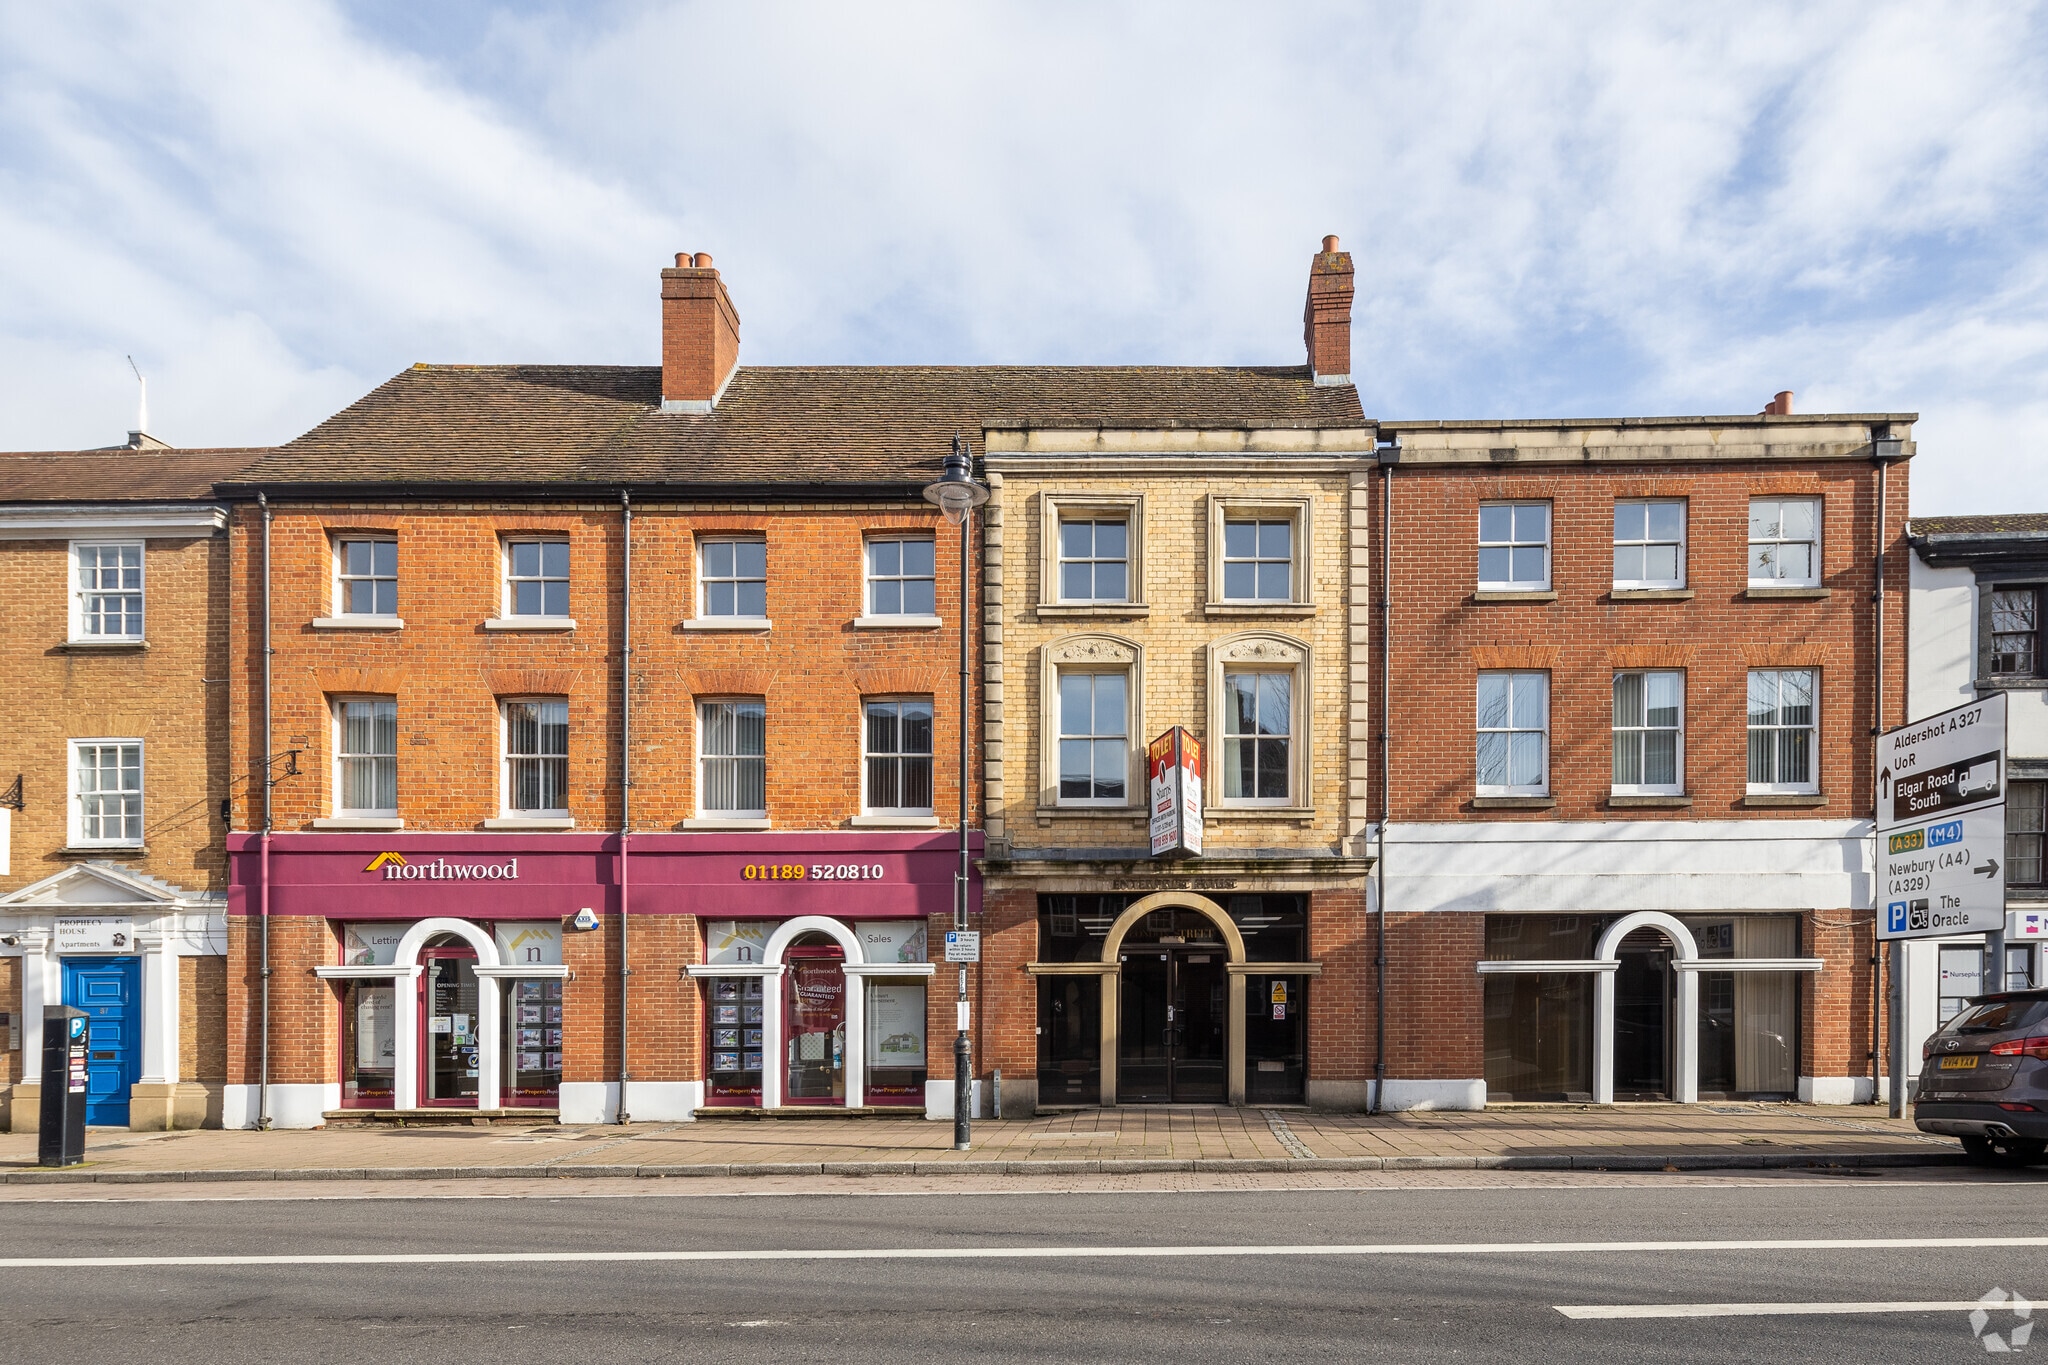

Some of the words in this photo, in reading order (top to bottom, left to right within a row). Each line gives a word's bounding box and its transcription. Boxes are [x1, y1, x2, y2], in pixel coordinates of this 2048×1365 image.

[1894, 722, 1945, 750] Aldershot
[1949, 708, 1982, 732] A327
[1151, 743, 1160, 762] TO
[1160, 734, 1173, 757] LET
[1182, 733, 1190, 754] TO
[1190, 742, 1199, 761] LET
[1894, 753, 1916, 771] UoR
[1897, 780, 1924, 798] Elgar
[1927, 769, 1956, 788] Road
[1909, 791, 1941, 811] South
[1889, 831, 1924, 853] (A33)
[1929, 822, 1961, 845] (M4)
[386, 857, 519, 879] northwood
[1889, 859, 1935, 877] Newbury
[1938, 848, 1971, 870] (A4)
[744, 864, 805, 879] 01189
[811, 864, 884, 879] 520810
[1194, 879, 1238, 889] HOUSE
[1888, 874, 1930, 895] (A329)
[1940, 895, 1961, 909] The
[59, 919, 104, 927] PROPHECY
[1932, 911, 1969, 928] Oracle
[60, 941, 101, 949] Apartments
[372, 936, 402, 945] Lettin
[867, 934, 892, 943] Sales
[1949, 971, 1982, 979] Nurseplus
[800, 992, 835, 1000] GUARANTEED
[1960, 1056, 1976, 1067] YXW
